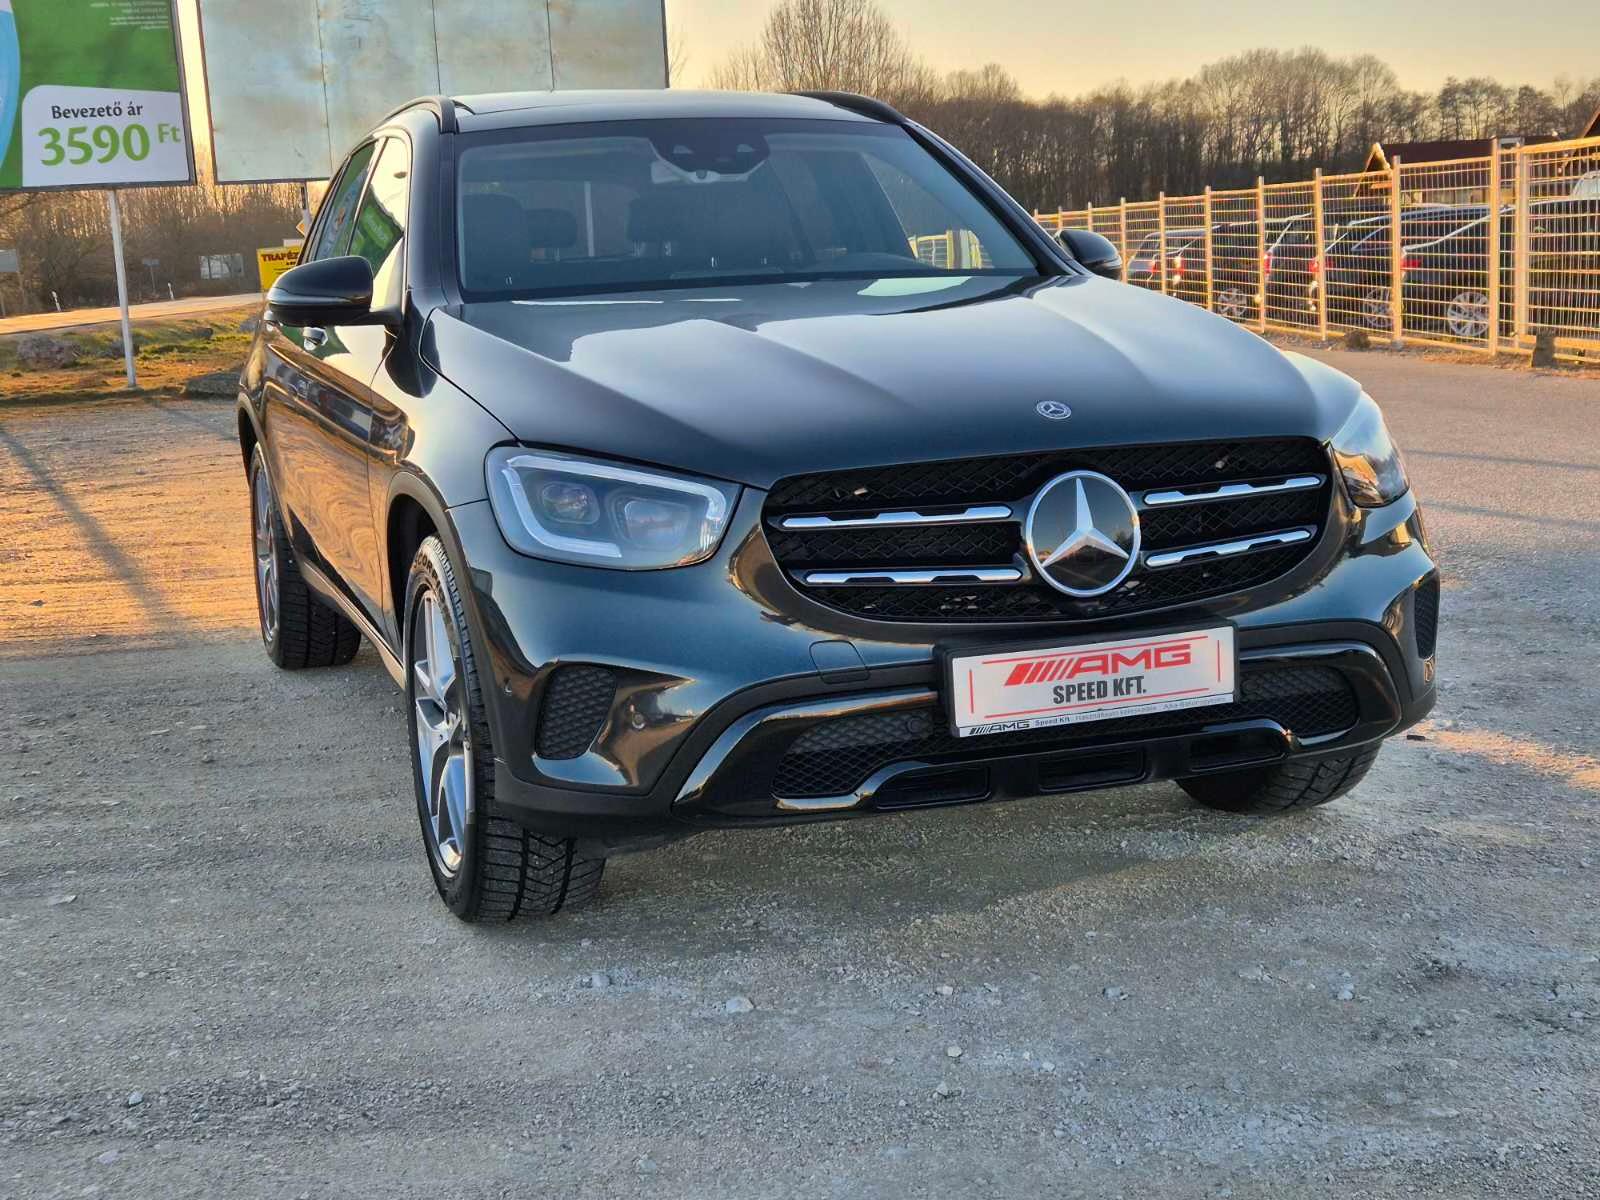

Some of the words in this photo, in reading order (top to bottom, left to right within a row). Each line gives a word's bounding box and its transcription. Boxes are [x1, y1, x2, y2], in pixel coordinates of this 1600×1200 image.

[51, 102, 123, 119] Bevezető
[127, 101, 143, 116] ár
[37, 123, 150, 166] 3590
[157, 124, 181, 143] Ft
[1068, 644, 1191, 679] AMG
[1053, 679, 1108, 704] SPEED
[1113, 675, 1147, 698] KFT.
[988, 720, 1031, 733] AMG
